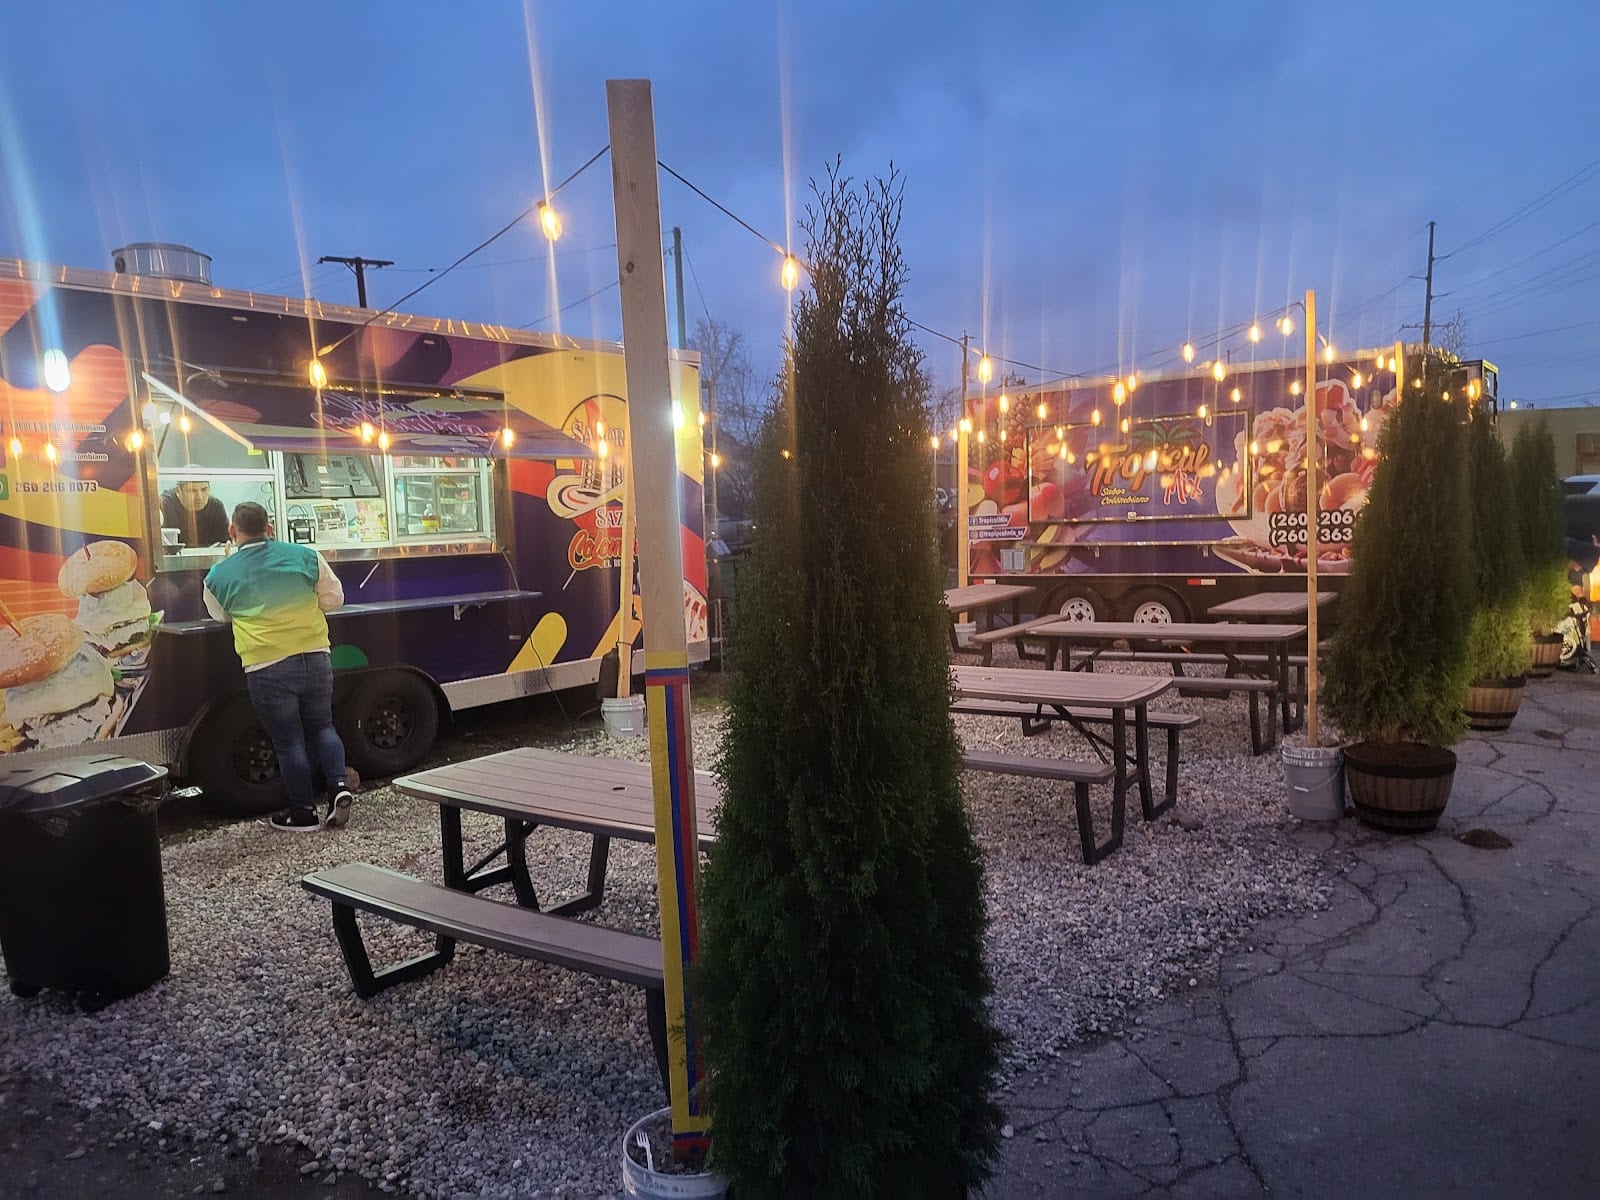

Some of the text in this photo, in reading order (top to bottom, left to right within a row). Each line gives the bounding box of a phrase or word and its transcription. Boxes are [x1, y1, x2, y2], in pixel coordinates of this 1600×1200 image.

[1085, 443, 1209, 496] Tropical
[1163, 468, 1203, 505] Mix
[595, 507, 623, 529] SAZ
[1271, 513, 1308, 529] (260
[1320, 511, 1353, 525] 206
[568, 529, 622, 571] Colom
[1271, 528, 1353, 547] (260 363
